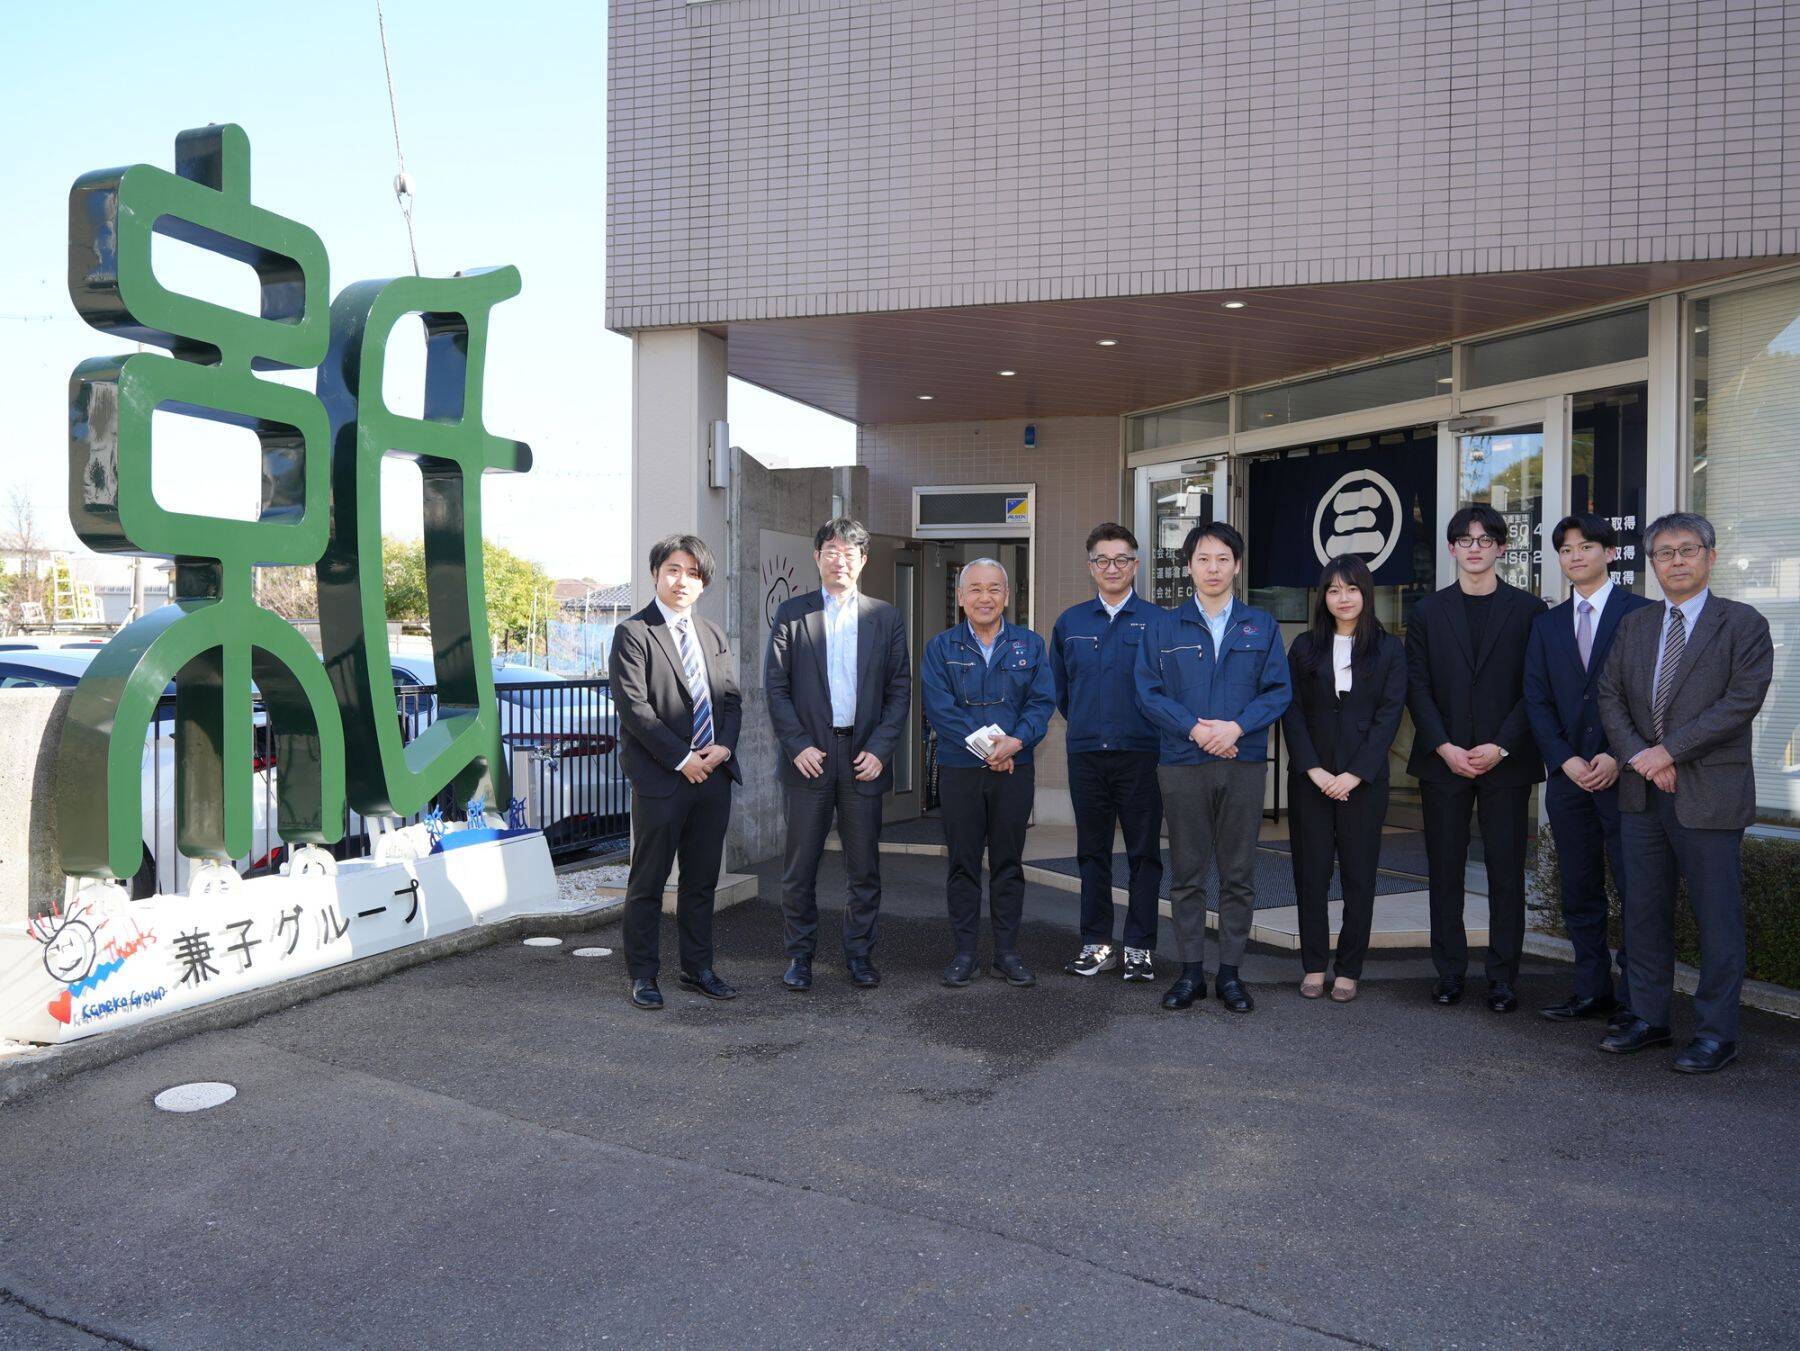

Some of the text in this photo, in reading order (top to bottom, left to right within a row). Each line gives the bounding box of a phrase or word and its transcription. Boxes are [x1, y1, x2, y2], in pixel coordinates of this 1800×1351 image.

[1508, 524, 1530, 539] SO
[1603, 515, 1636, 532] 取得
[173, 879, 420, 984] 兼子グループ
